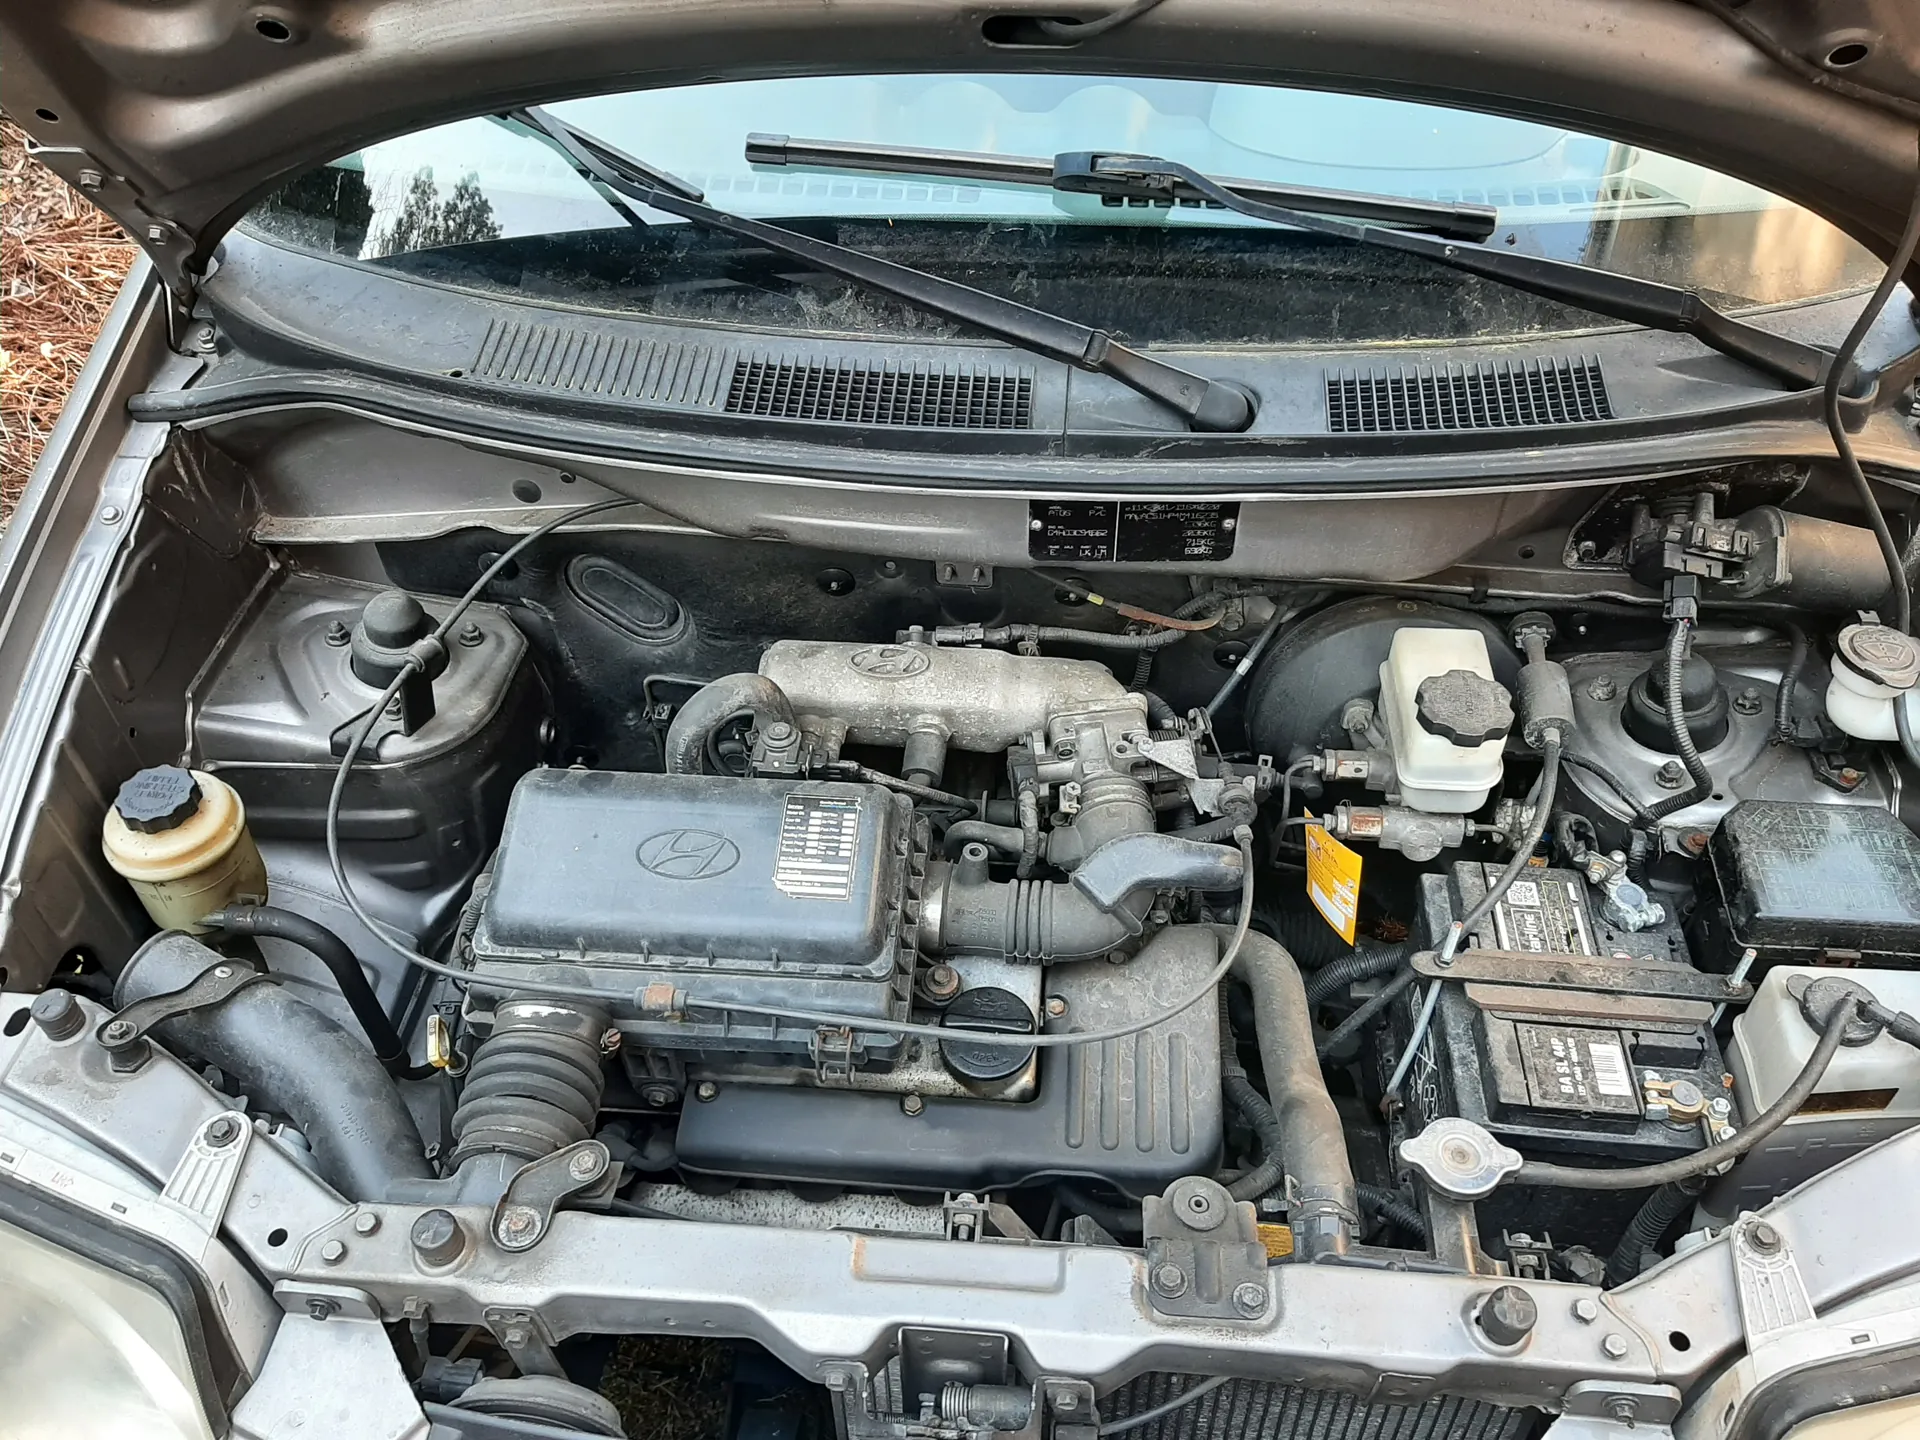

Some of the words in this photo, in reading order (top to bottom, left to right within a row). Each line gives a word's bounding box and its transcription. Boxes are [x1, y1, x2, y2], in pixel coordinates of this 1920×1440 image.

[1524, 912, 1542, 953] tarline
[1550, 1037, 1566, 1060] 44P
[1556, 1058, 1570, 1075] SL
[1558, 1076, 1575, 1094] BA
